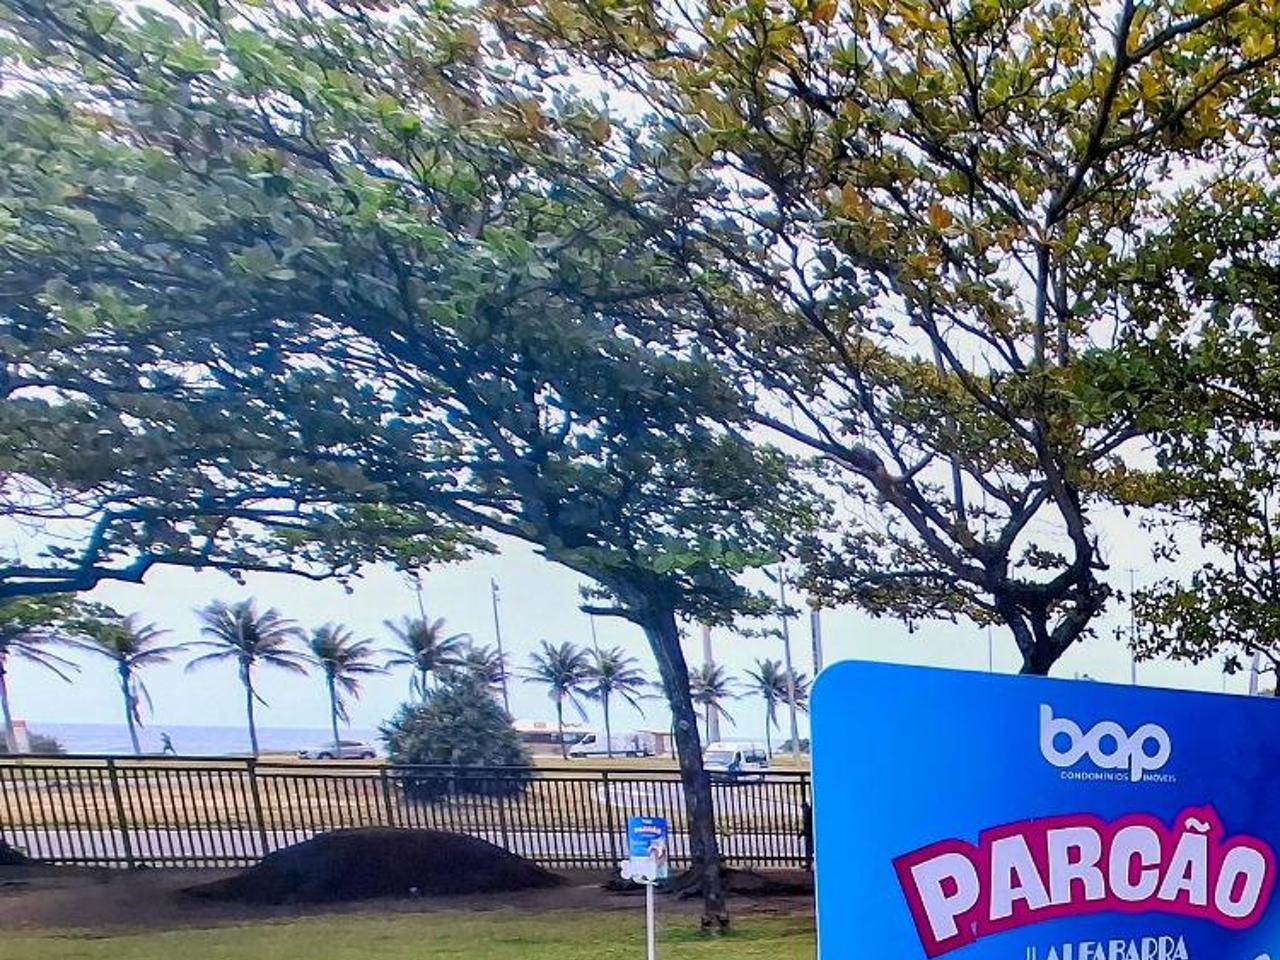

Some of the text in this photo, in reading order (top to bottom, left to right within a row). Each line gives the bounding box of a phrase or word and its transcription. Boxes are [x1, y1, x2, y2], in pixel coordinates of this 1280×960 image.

[1040, 703, 1171, 782] bap
[1060, 770, 1129, 781] CONDOMÍNIOS
[910, 817, 1266, 943] PARCÃO
